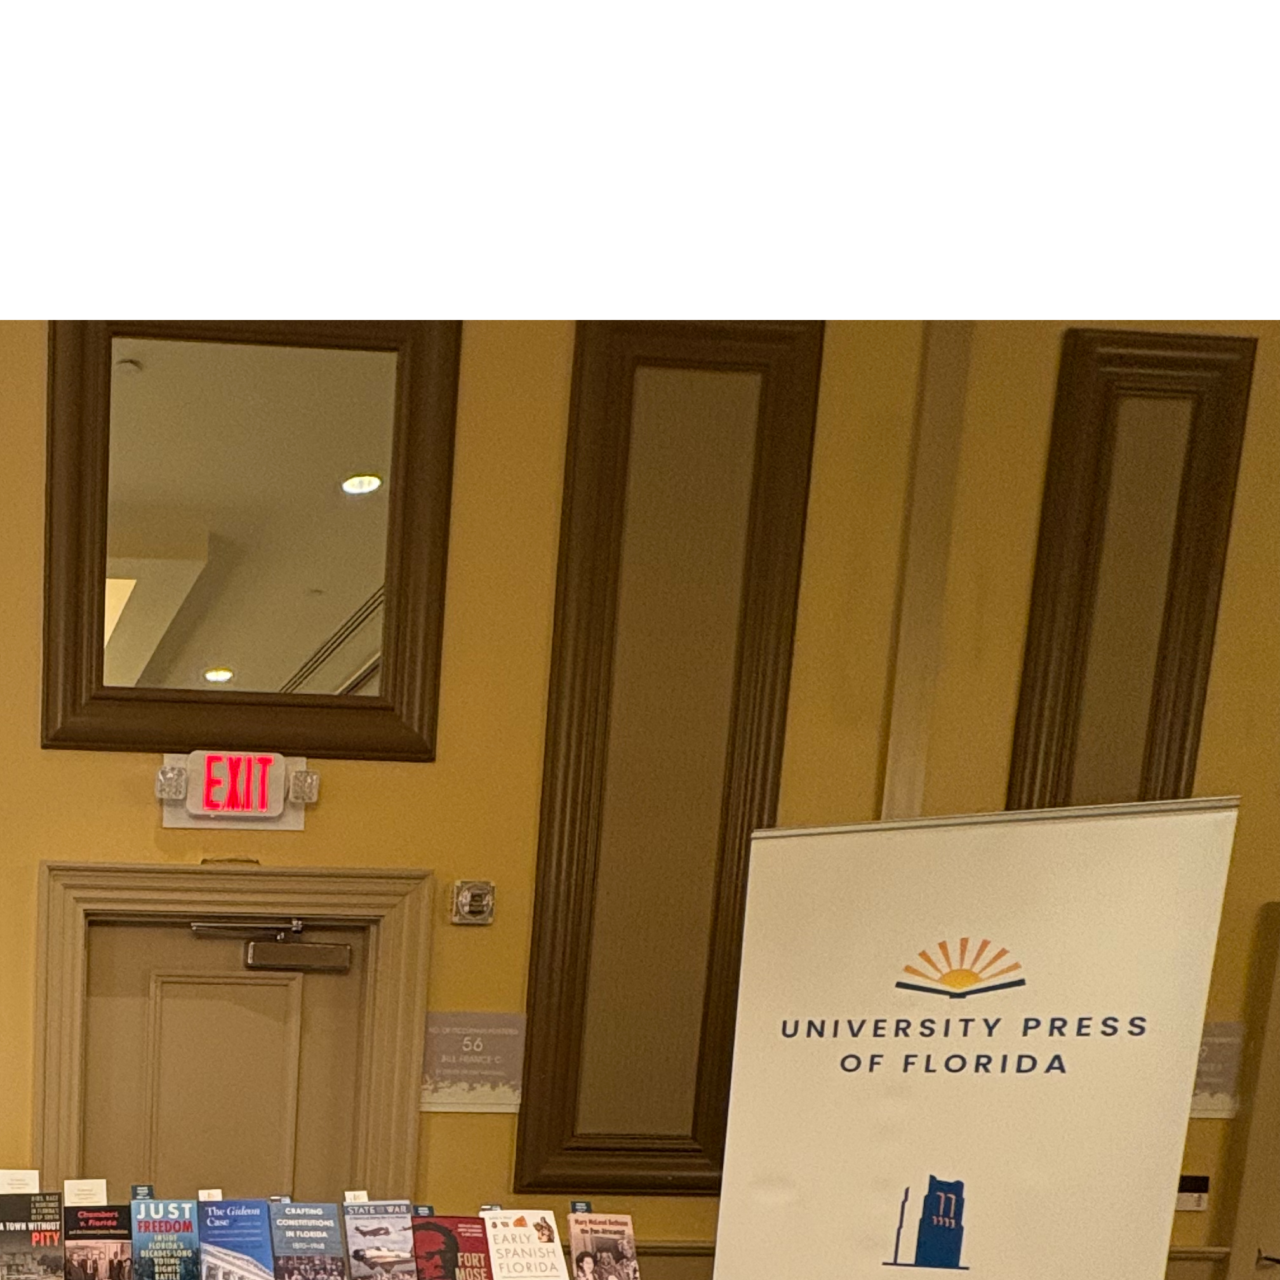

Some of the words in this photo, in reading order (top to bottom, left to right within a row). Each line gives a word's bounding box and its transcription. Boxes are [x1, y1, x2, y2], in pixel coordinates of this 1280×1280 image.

[203, 753, 274, 812] EXIT
[781, 1018, 1002, 1038] UNIVERSITY
[1021, 1016, 1148, 1036] PRESS
[462, 1037, 483, 1051] 56
[840, 1054, 884, 1073] OF
[903, 1054, 1067, 1074] FLORIDA
[137, 1203, 192, 1219] JUST
[205, 1207, 225, 1216] The
[227, 1206, 260, 1215] Gideon
[348, 1206, 375, 1214] STATE
[386, 1205, 407, 1213] WAR
[0, 1222, 4, 1230] A
[6, 1222, 26, 1230] TOWN
[28, 1222, 60, 1230] WITHOUT
[137, 1221, 193, 1233] FREEDOM
[207, 1217, 229, 1226] Case
[276, 1219, 334, 1227] CONSTITUTIONS
[574, 1219, 587, 1227] Mary
[31, 1232, 60, 1247] PITY
[493, 1233, 534, 1245] EARLY
[496, 1248, 557, 1259] SPANISH
[457, 1253, 485, 1267] FORT
[498, 1261, 559, 1274] FLORIDA
[155, 1273, 180, 1280] BATTLE
